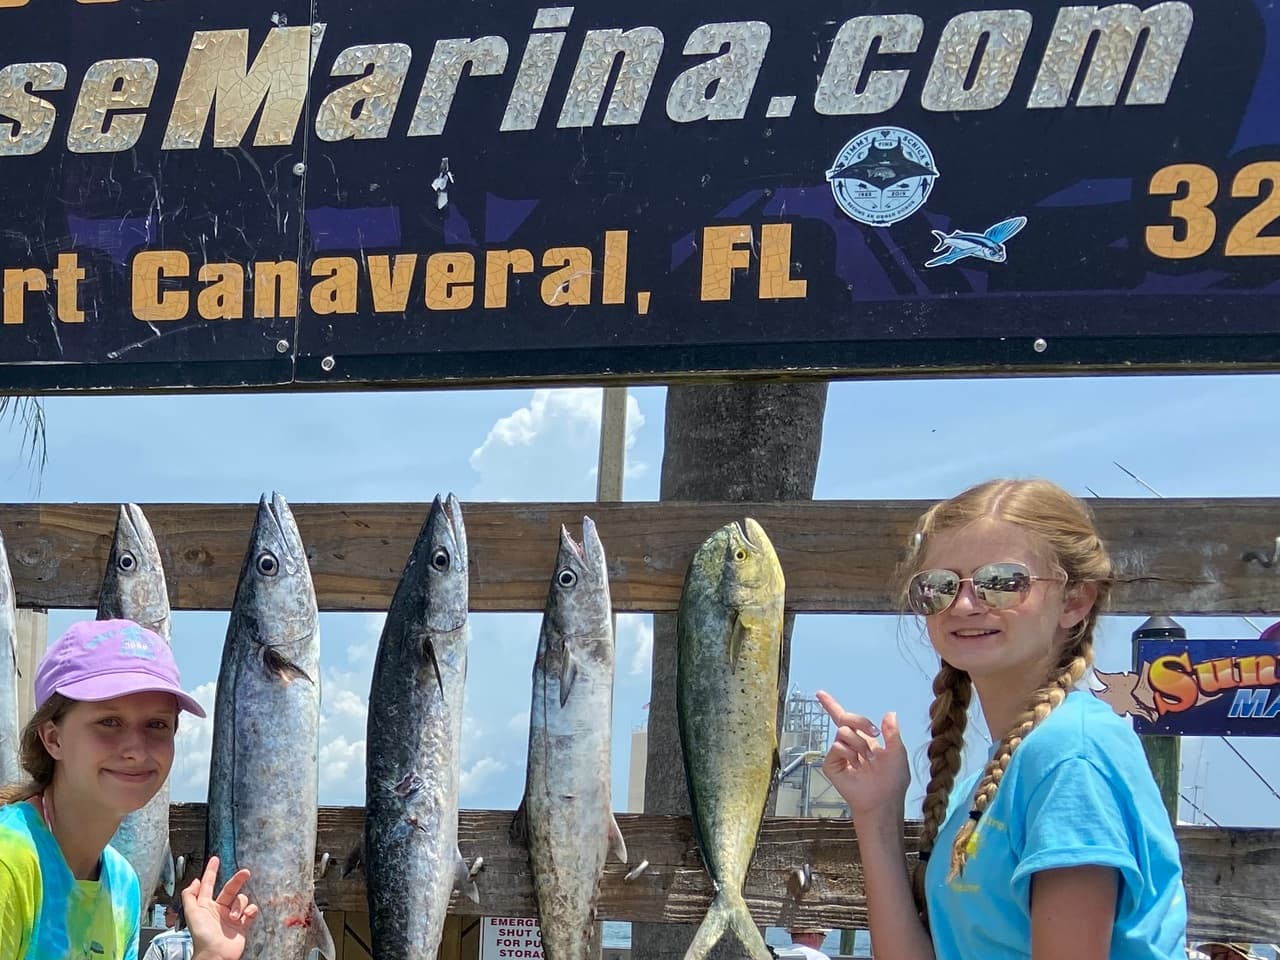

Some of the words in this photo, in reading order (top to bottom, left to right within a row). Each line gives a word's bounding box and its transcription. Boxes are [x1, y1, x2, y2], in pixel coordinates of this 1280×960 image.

[844, 136, 869, 161] JIMMY
[903, 136, 927, 161] SCHICK
[1145, 161, 1280, 260] 32
[131, 229, 650, 321] Canaveral,
[700, 223, 808, 302] FL
[1148, 651, 1280, 716] Sun
[496, 939, 520, 947] FOR
[498, 928, 532, 937] SHUT
